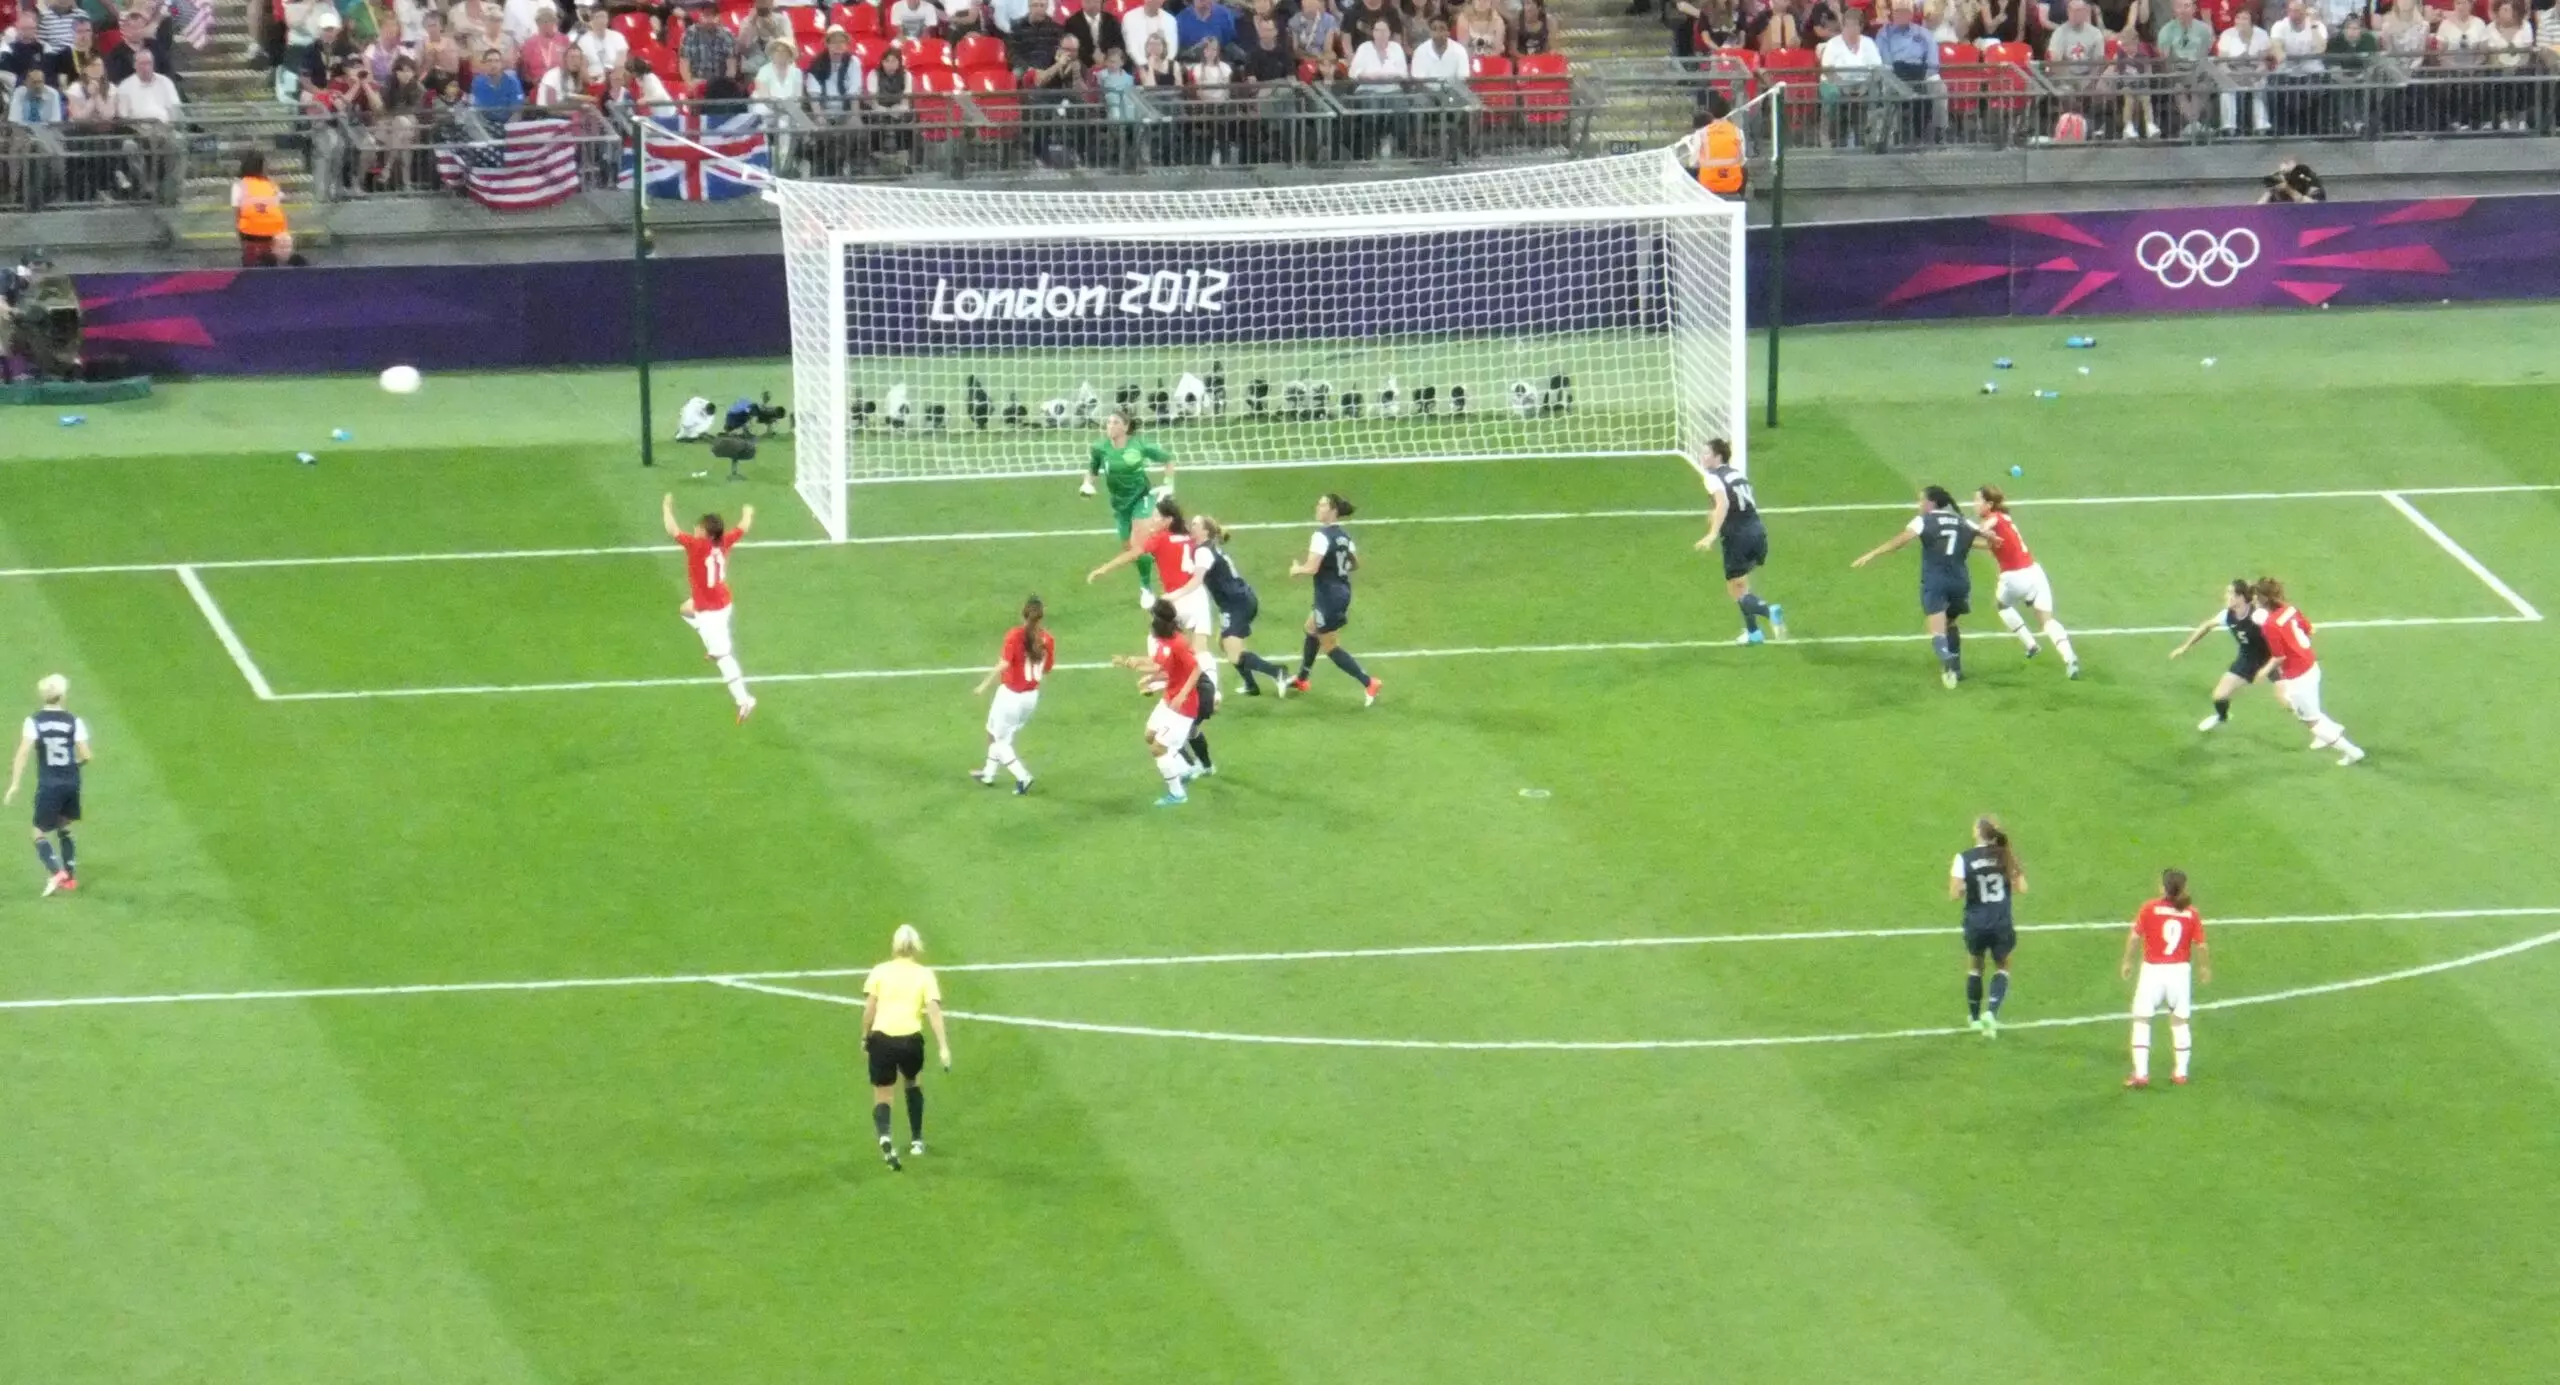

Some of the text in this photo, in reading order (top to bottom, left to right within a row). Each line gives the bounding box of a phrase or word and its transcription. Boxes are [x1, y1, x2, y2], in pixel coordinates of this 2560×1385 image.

[930, 267, 1230, 321] London 2012
[1940, 529, 1957, 555] 7
[704, 552, 725, 588] 11
[43, 737, 71, 767] 15
[1976, 873, 2006, 903] 13
[2162, 918, 2183, 956] 9
